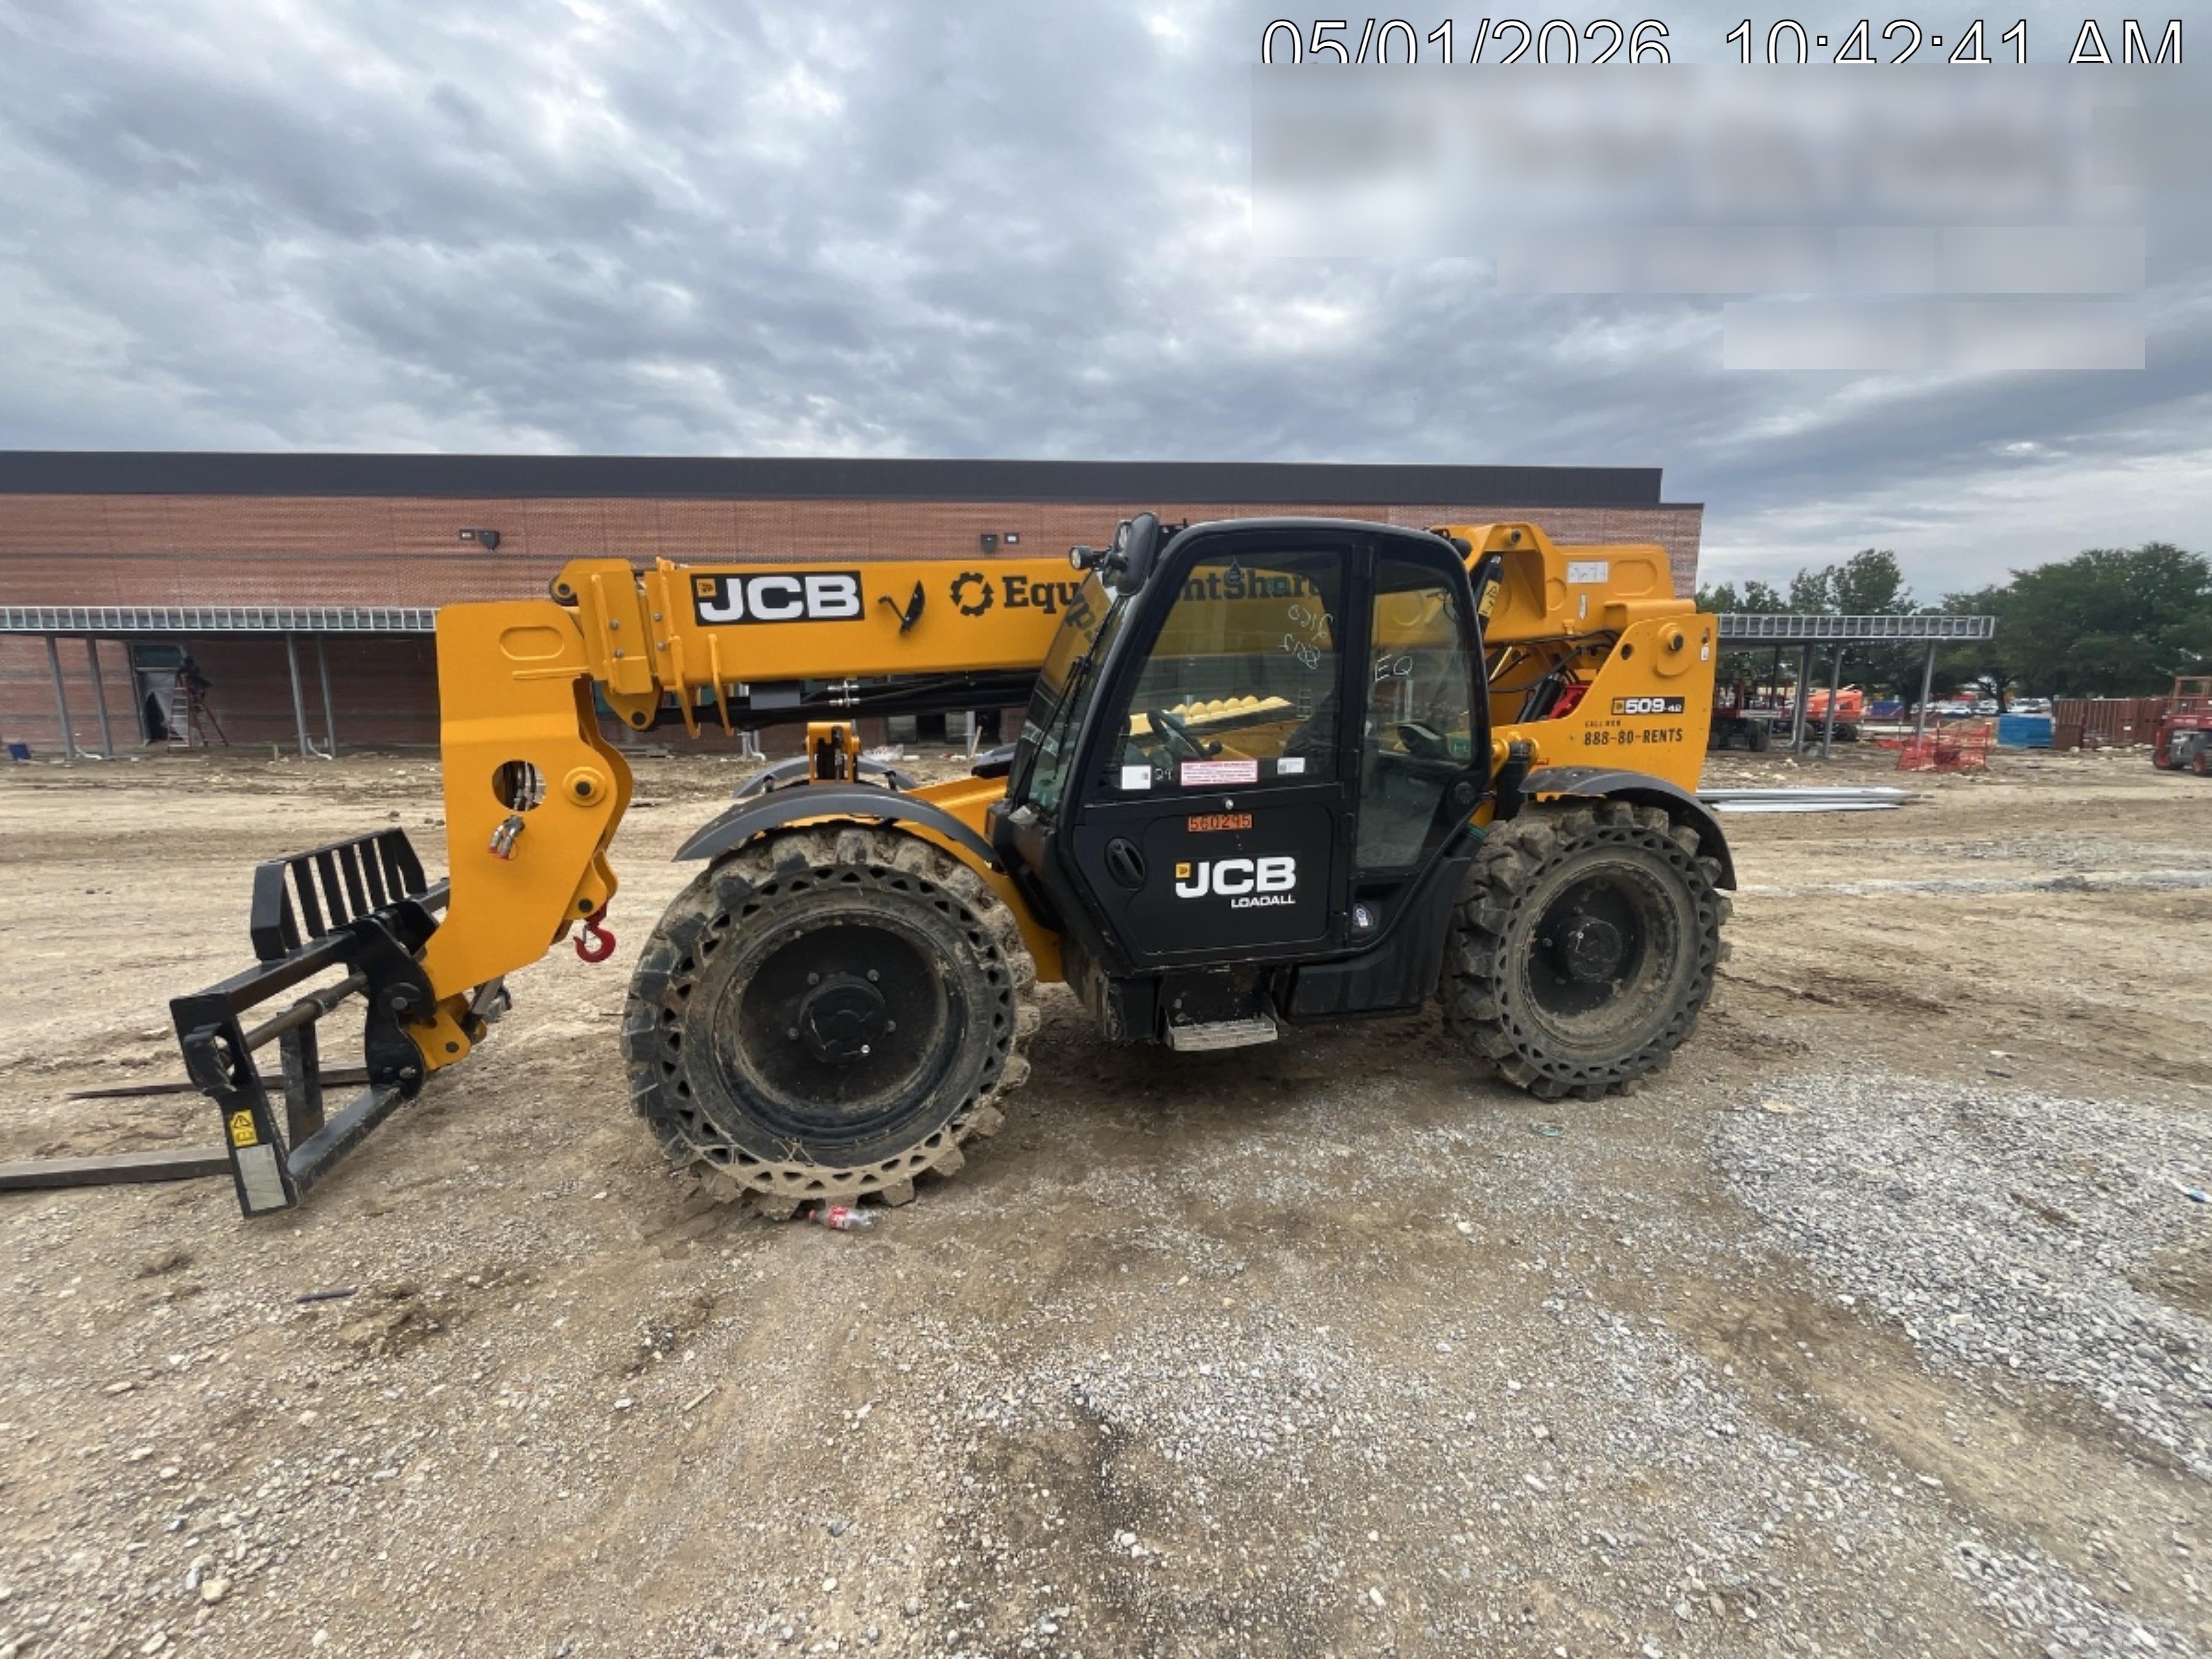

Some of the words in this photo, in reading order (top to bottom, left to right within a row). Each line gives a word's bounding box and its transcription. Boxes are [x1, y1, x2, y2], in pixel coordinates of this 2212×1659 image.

[698, 575, 860, 622] JCB
[1584, 728, 1683, 745] 888-80-RENTS
[1175, 857, 1296, 898] JCB
[1231, 895, 1296, 908] LOADALL
